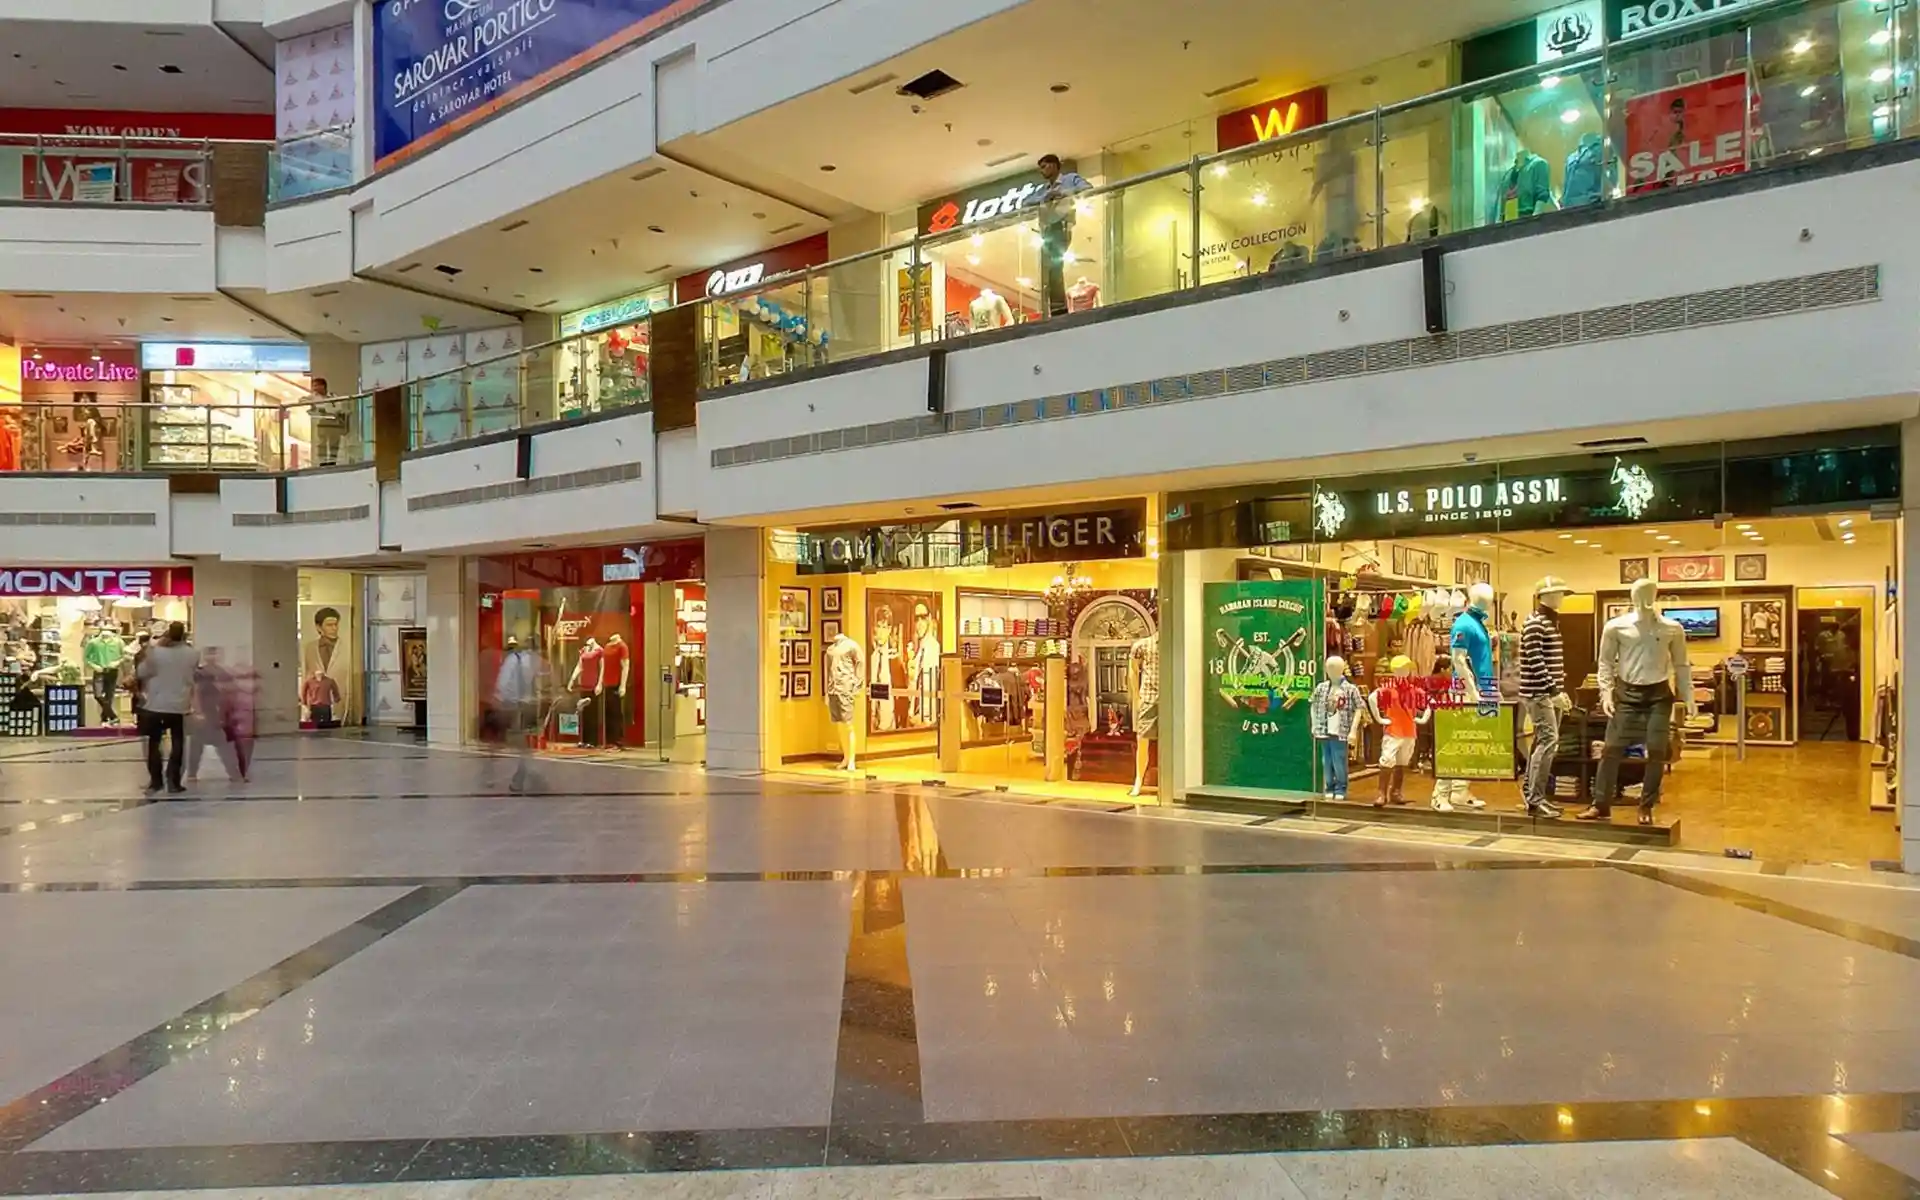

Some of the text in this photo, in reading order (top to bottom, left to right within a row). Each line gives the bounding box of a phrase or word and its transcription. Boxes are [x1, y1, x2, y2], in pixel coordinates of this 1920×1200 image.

[394, 0, 557, 99] SAROVAR PORTICO
[429, 70, 513, 124] A SAROVAR HOTEL
[65, 125, 181, 143] NOW OPEN
[1251, 102, 1298, 142] W
[1630, 131, 1743, 182] SALE
[1202, 223, 1307, 257] NEW COLLECTION
[1377, 477, 1567, 515] U.S. POLO ASSN.
[1424, 507, 1513, 523] SINCE 1890
[811, 516, 1116, 560] TOMMY HILFIGER
[1253, 631, 1271, 643] EST.
[1242, 719, 1280, 735] USPA
